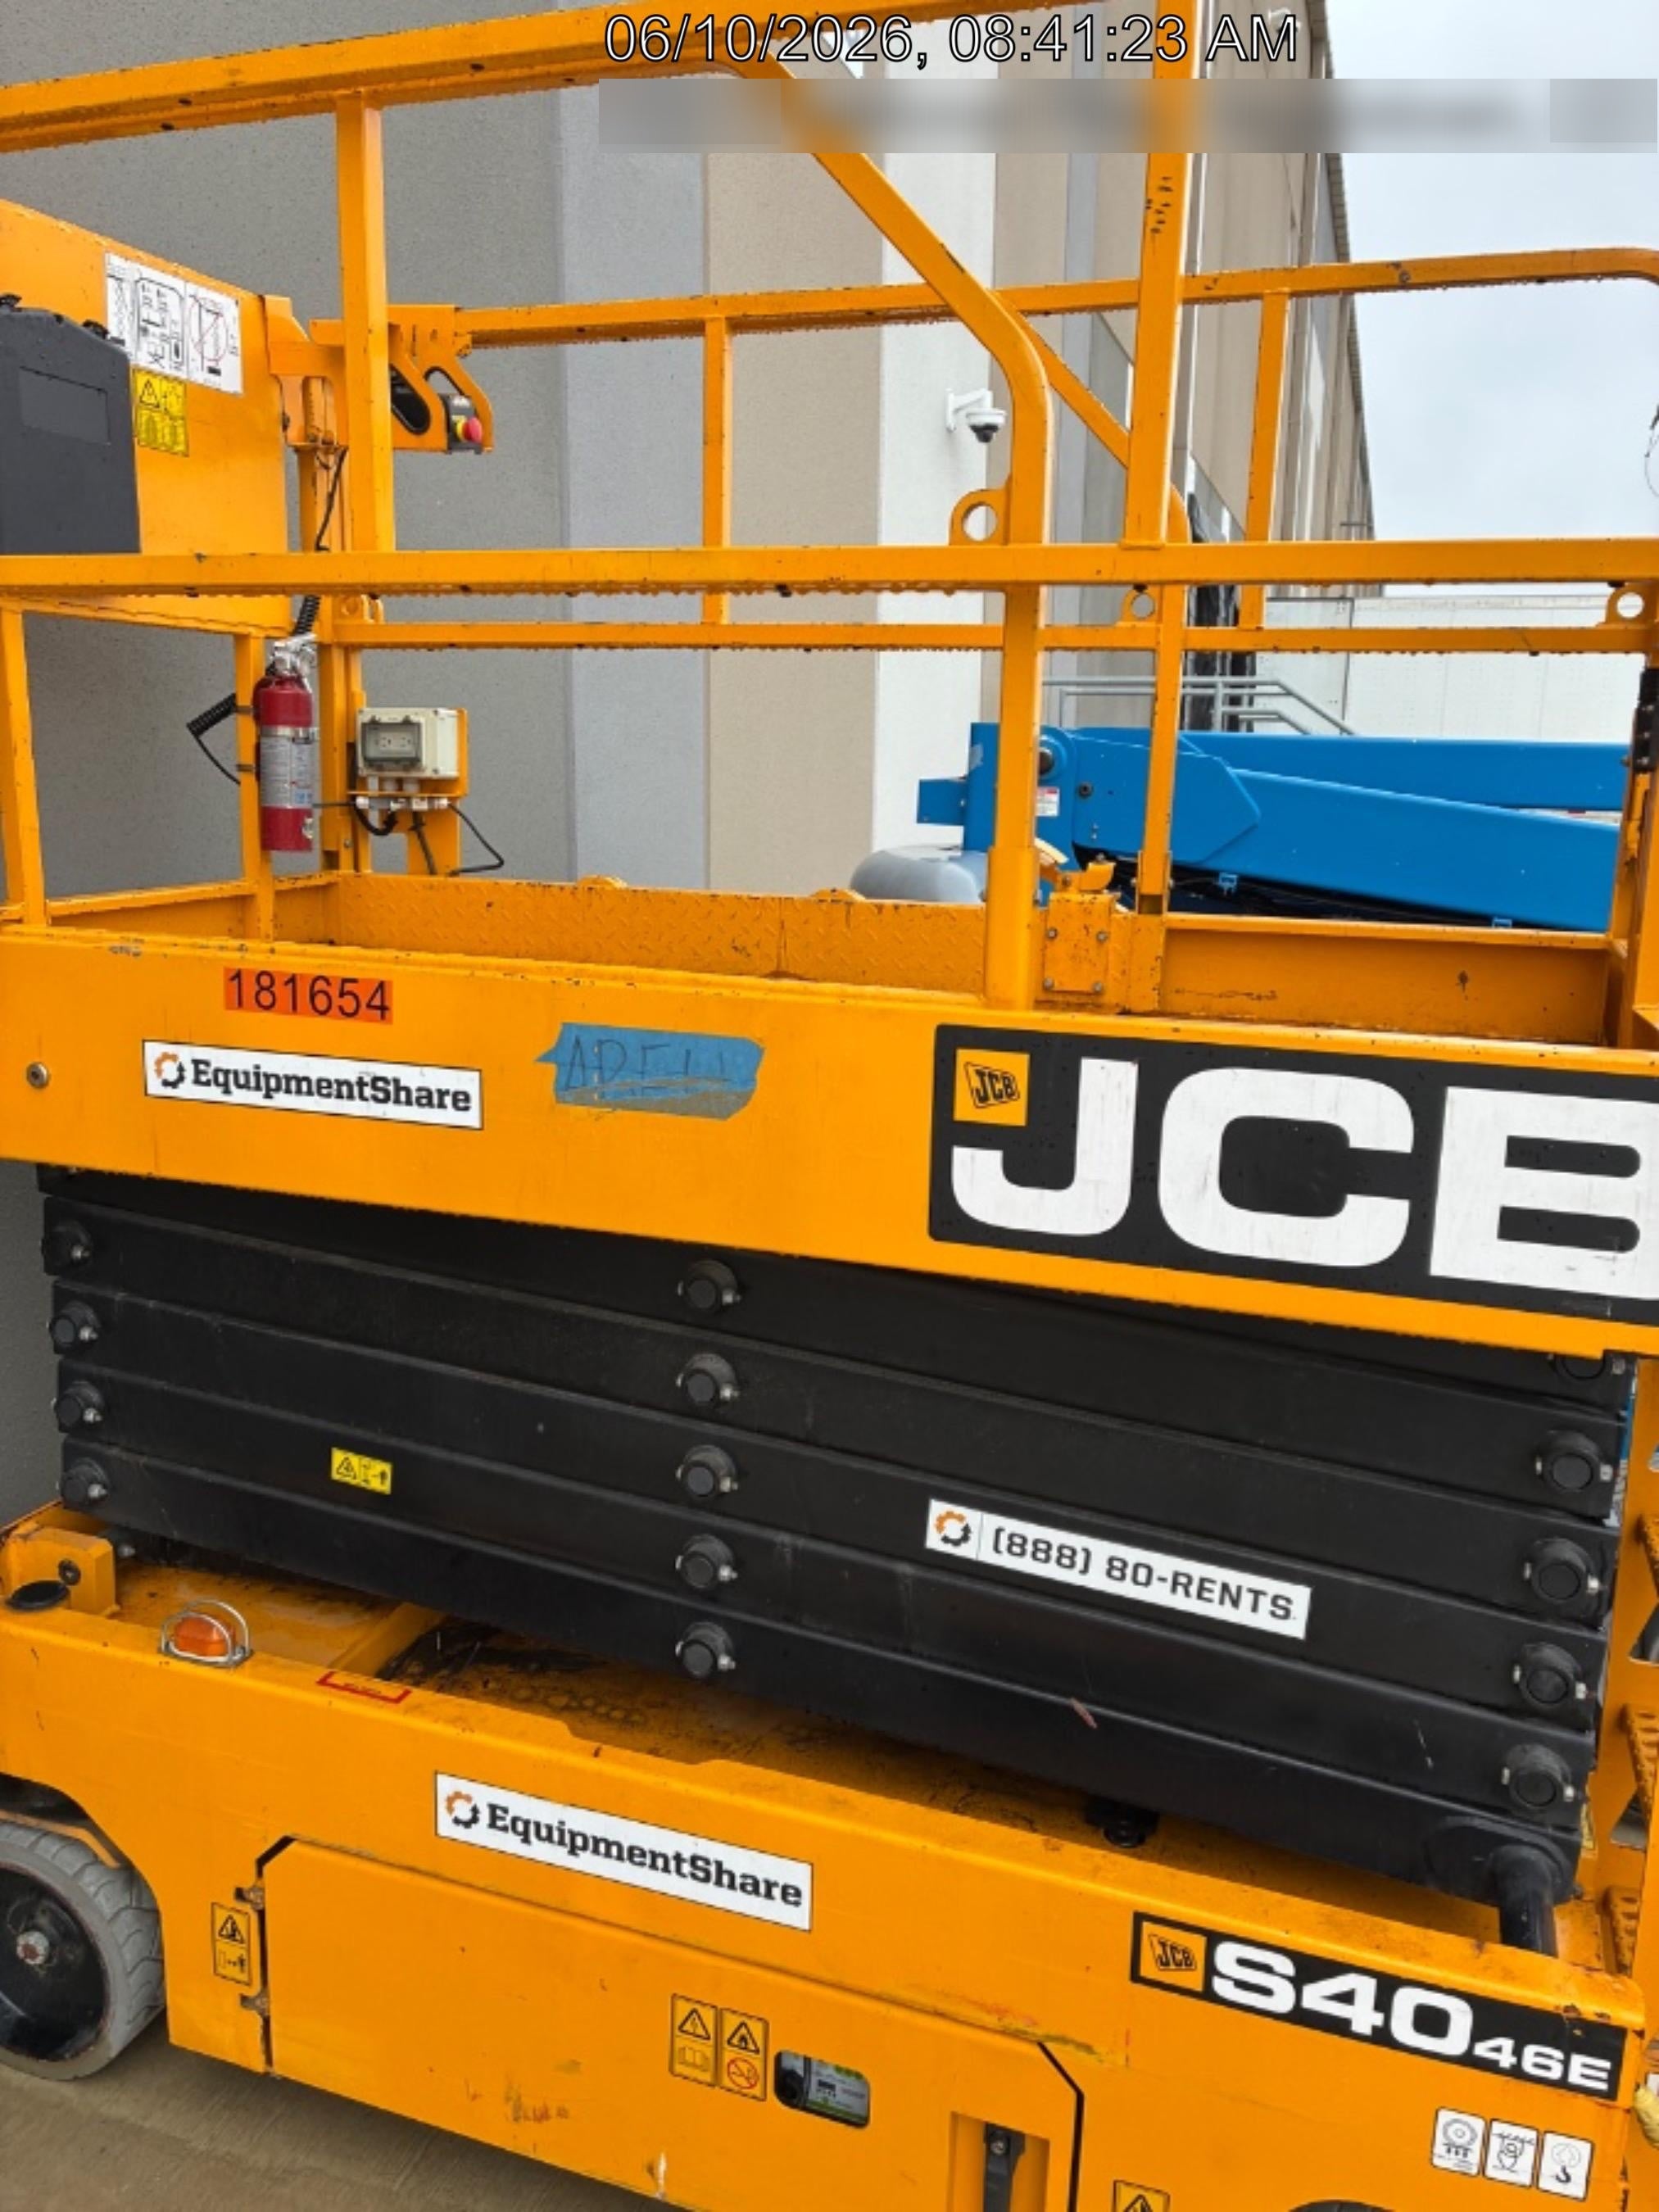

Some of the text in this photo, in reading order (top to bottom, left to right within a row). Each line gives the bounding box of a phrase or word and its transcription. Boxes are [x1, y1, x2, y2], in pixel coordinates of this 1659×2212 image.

[229, 969, 390, 1021] 181654
[191, 1058, 472, 1112] EquipmentShare
[972, 1067, 1017, 1104] JCB
[950, 1056, 1659, 1301] JCB
[992, 1527, 1294, 1621] (888) 80-RENTS
[487, 1802, 803, 1908] EquipmentShare
[1156, 1938, 1195, 1968] JCB
